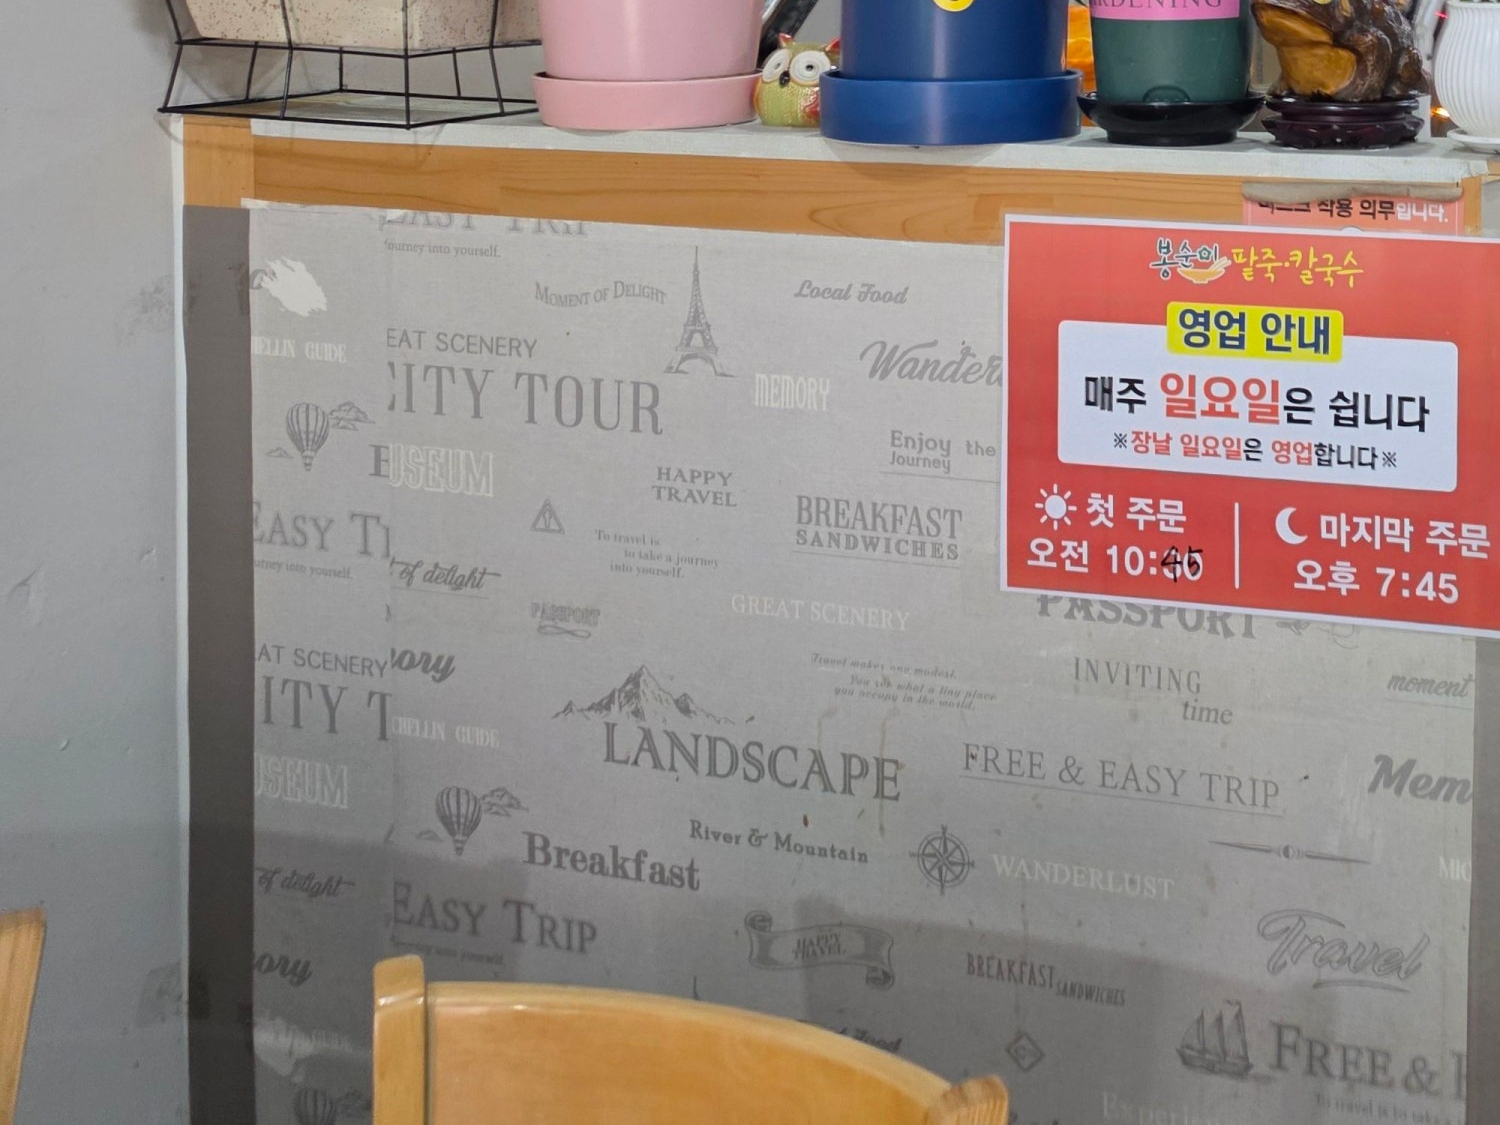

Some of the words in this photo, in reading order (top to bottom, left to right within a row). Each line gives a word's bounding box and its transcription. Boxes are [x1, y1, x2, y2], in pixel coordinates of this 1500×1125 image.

[428, 244, 451, 255] into
[794, 279, 851, 301] Local
[857, 283, 910, 306] Food
[435, 331, 538, 359] SCENERY
[1178, 308, 1247, 352] 영업
[1260, 312, 1332, 356] 안내
[386, 361, 496, 421] ITY
[514, 370, 664, 437] TOUR
[753, 373, 831, 412] MEMORY
[1084, 375, 1147, 415] 매주
[1159, 372, 1317, 427] 일요일은
[1328, 389, 1431, 433] 쉽니다
[889, 430, 951, 458] Enjoy
[966, 439, 997, 458] the
[889, 450, 951, 475] Journey
[1180, 433, 1264, 464] 일요일은
[651, 484, 738, 508] TRAVEL
[656, 466, 733, 487] HAPPY
[796, 495, 963, 540] BREAKFAST
[1086, 492, 1115, 530] 첫
[1126, 496, 1187, 535] 주문
[614, 533, 646, 546] travel
[795, 529, 960, 561] SANDWICHES
[1320, 512, 1414, 553] 마지막
[1425, 519, 1491, 560] 주문
[610, 559, 632, 573] into
[639, 549, 663, 561] take
[675, 553, 719, 570] journey
[1026, 538, 1090, 574] 오전
[423, 562, 501, 592] delight
[1293, 559, 1360, 597] 오후
[1375, 567, 1459, 604] 7:45
[731, 593, 802, 620] GREAT
[811, 598, 911, 632] SCENERY
[293, 647, 388, 679] SCENERY
[1074, 655, 1202, 695] INVITING
[1386, 671, 1474, 700] moment
[1181, 698, 1234, 726] time
[602, 721, 902, 802] LANDSCAPE
[962, 741, 1046, 782] FREE
[1057, 754, 1086, 786] &
[1099, 759, 1188, 798] EASY
[1199, 771, 1281, 810] TRIP
[690, 818, 742, 846] River
[748, 827, 769, 848] &
[773, 831, 870, 864] Mountain
[521, 831, 701, 892] Breakfast
[991, 853, 1175, 900] WANDERLUST
[391, 881, 488, 938] EASY
[503, 898, 598, 956] TRIP
[1257, 908, 1430, 980] Travel
[966, 952, 1055, 989] BREAKFAST
[1055, 980, 1126, 1007] SANDWICHES
[1268, 1019, 1393, 1088] FREE
[1402, 1054, 1443, 1097] &
